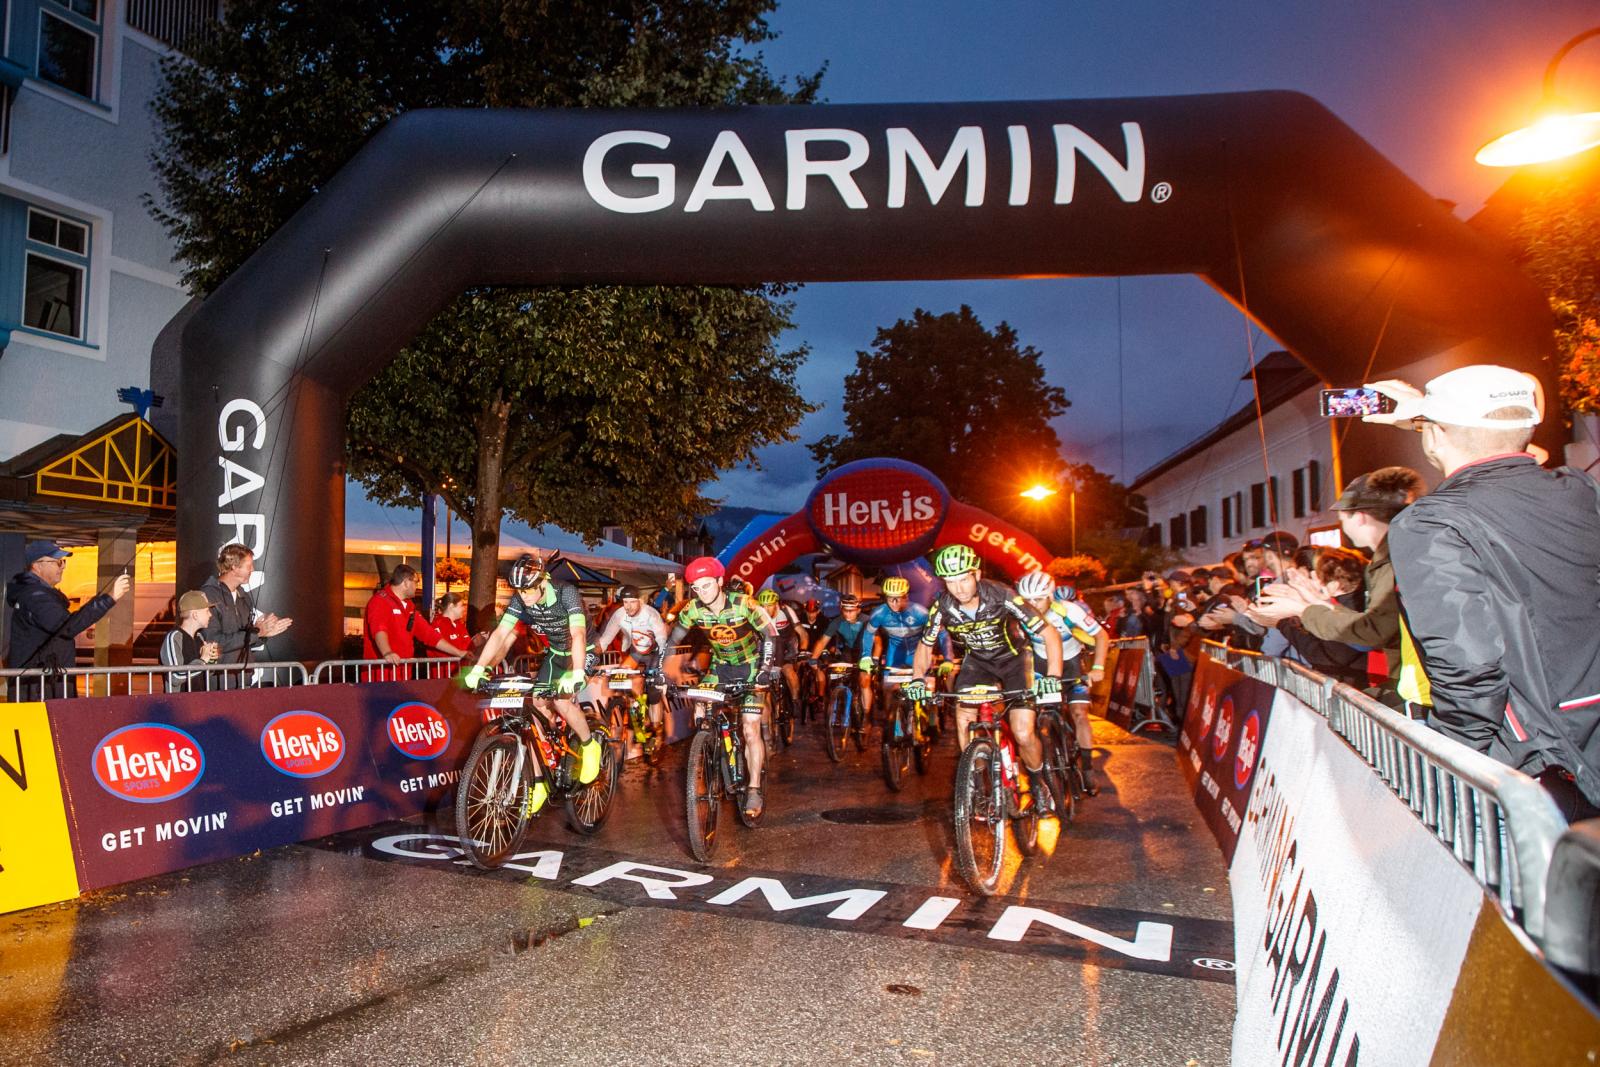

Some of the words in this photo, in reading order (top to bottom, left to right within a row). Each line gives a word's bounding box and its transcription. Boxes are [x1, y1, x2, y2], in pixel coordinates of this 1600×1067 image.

[582, 121, 1146, 214] GARMIN
[824, 490, 935, 531] Hervis
[968, 523, 1017, 554] get
[268, 727, 339, 761] Hervis
[392, 717, 446, 745] Hervis
[103, 742, 197, 783] Hervis
[271, 798, 304, 818] GET
[311, 786, 364, 810] MOVIN'
[400, 776, 424, 793] GET
[102, 826, 146, 852] GET
[155, 812, 228, 842] MOVIN'
[371, 833, 1174, 962] GARMIN
